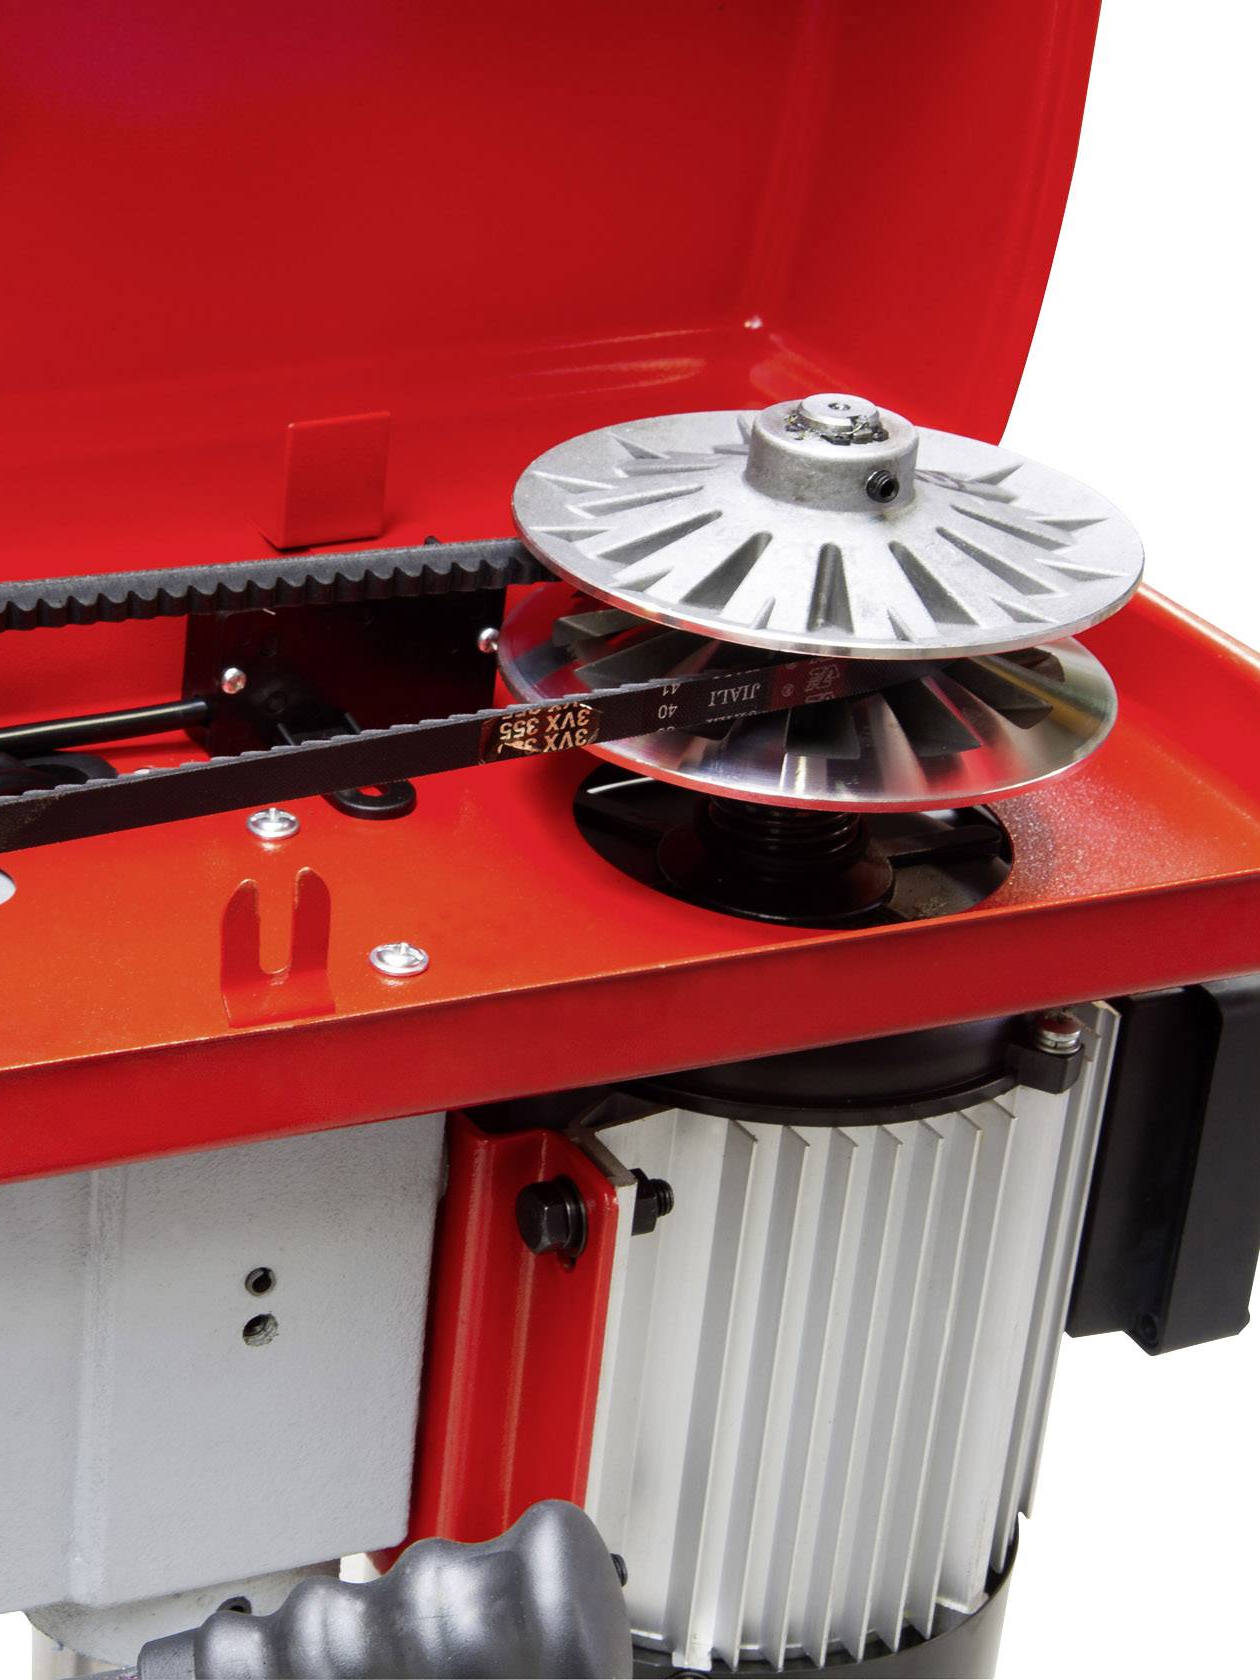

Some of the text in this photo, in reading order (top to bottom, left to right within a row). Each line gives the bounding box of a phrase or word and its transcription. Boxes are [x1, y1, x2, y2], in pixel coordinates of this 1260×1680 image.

[707, 682, 761, 707] JIALI
[545, 709, 591, 733] 3VX
[658, 704, 678, 720] 40
[500, 717, 539, 740] 355
[543, 728, 588, 753] 3VX
